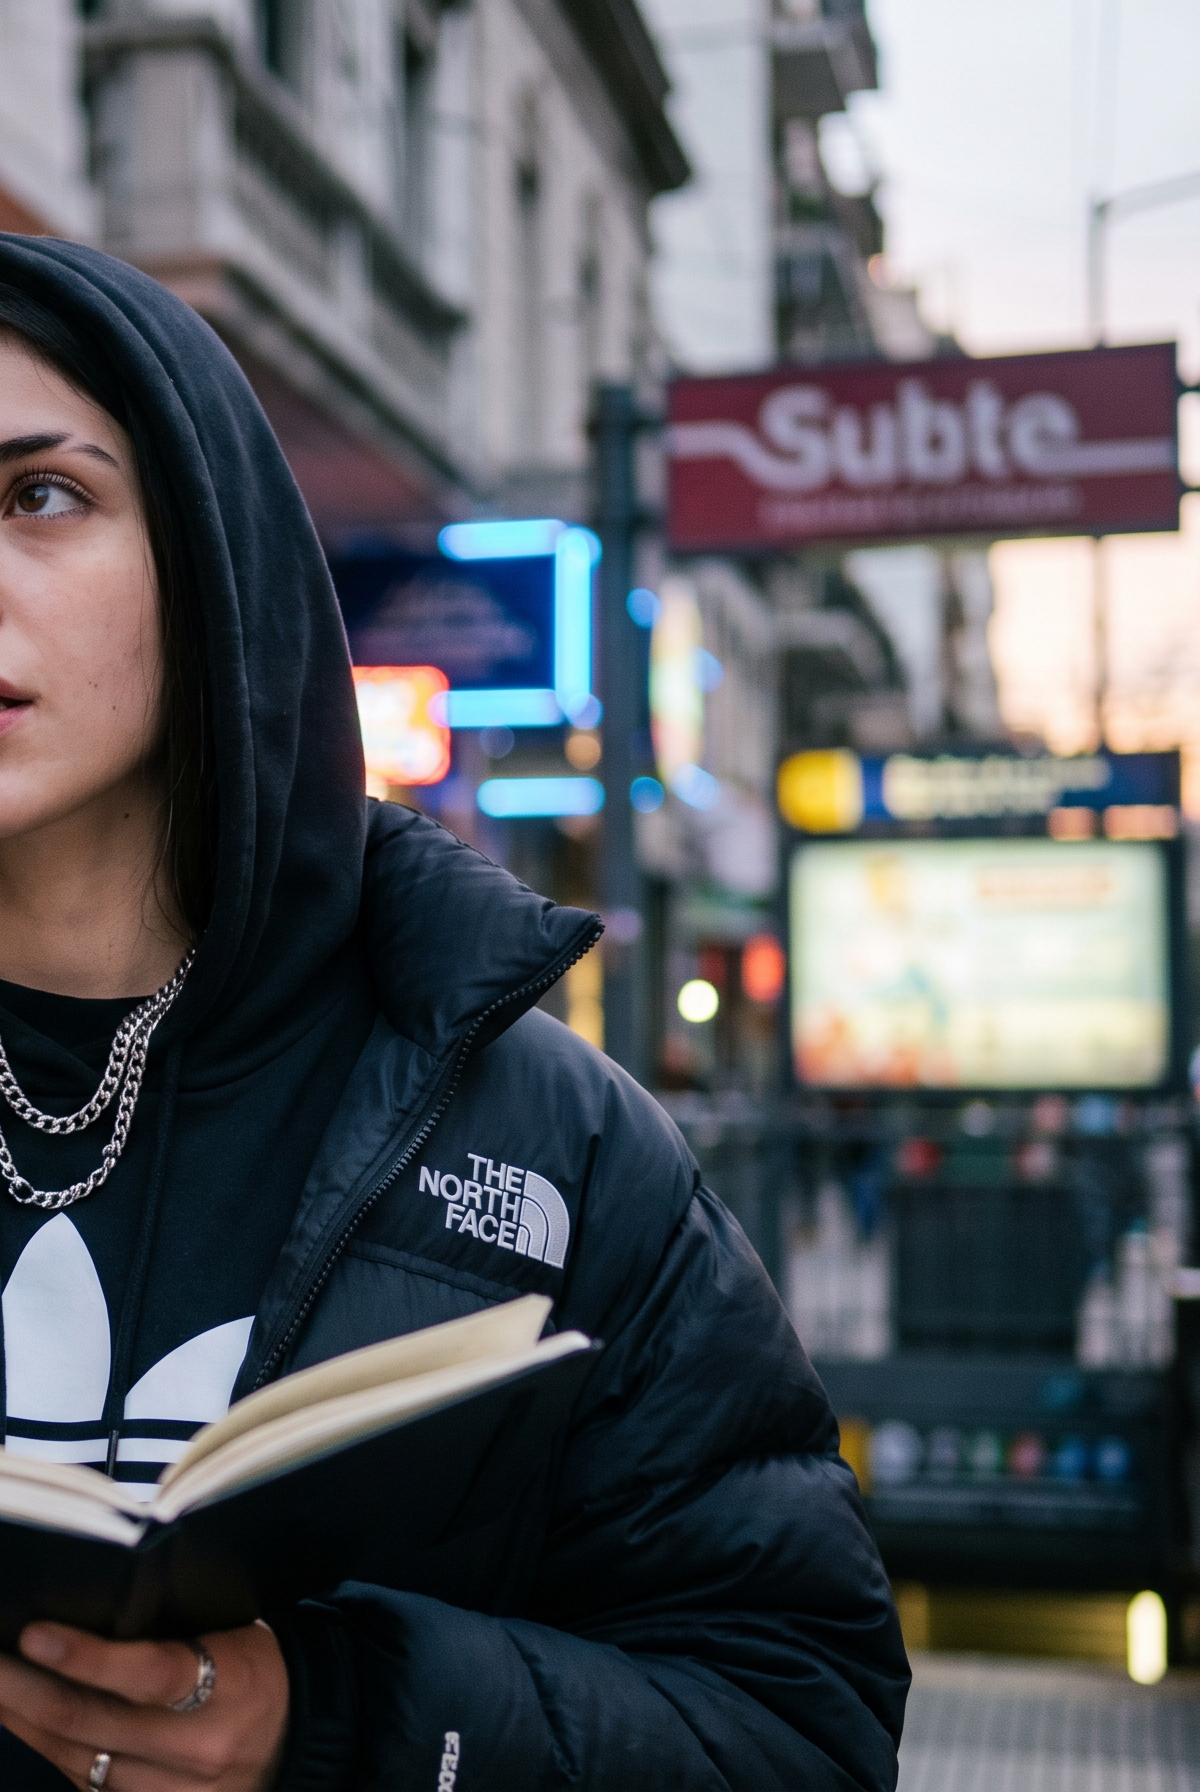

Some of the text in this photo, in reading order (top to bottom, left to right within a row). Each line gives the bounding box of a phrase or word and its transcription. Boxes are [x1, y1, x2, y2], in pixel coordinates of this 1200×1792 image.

[750, 377, 1082, 493] Subte
[418, 1166, 522, 1225] NORTH
[467, 1152, 526, 1195] THE
[445, 1202, 518, 1251] FACE
